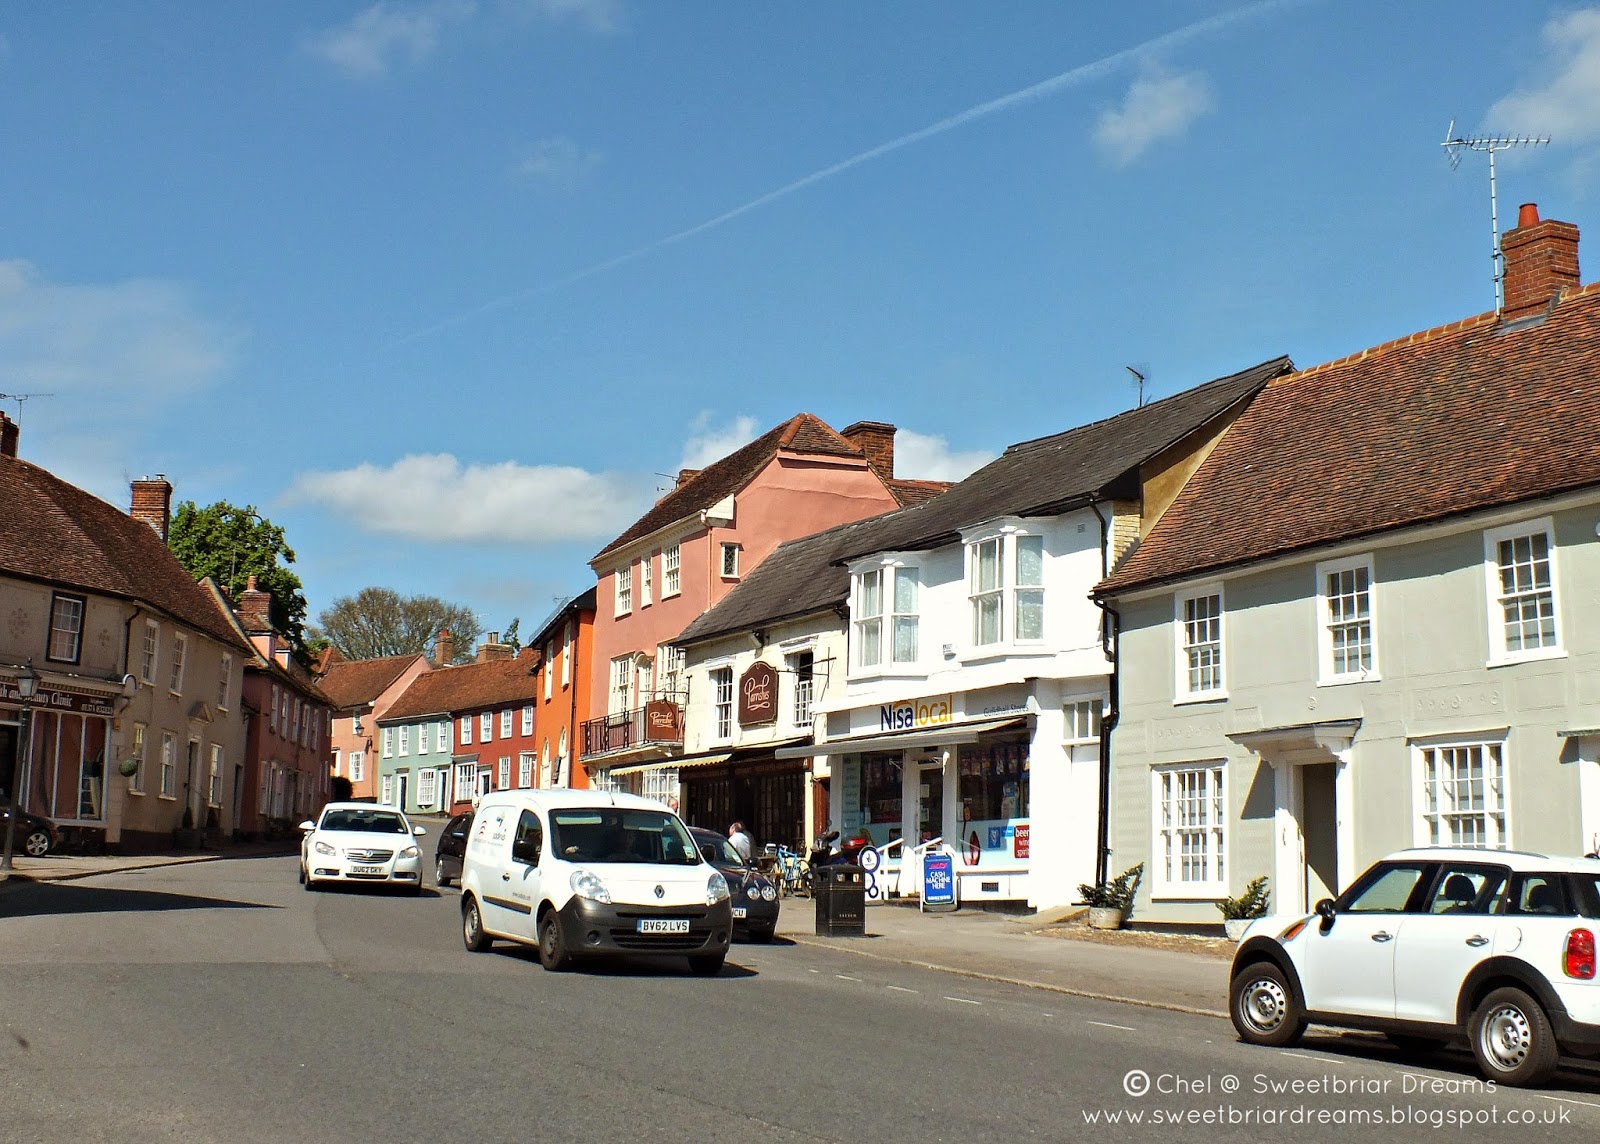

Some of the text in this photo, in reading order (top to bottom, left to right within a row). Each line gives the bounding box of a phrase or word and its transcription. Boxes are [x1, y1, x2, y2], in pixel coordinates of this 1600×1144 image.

[51, 692, 73, 707] Clinic
[643, 921, 688, 931] BV62 LVS
